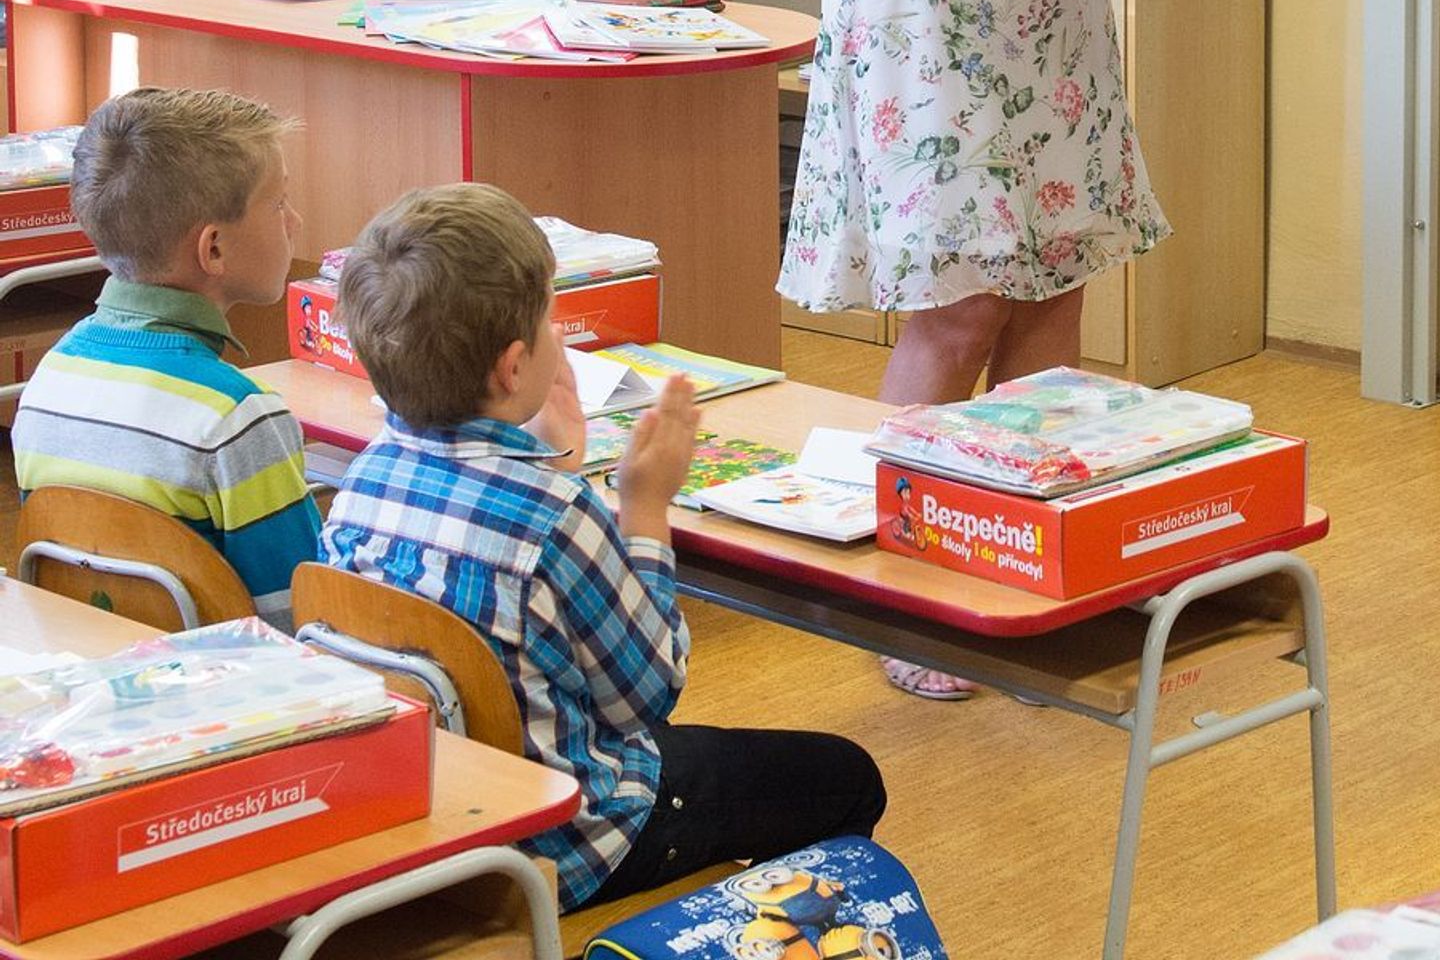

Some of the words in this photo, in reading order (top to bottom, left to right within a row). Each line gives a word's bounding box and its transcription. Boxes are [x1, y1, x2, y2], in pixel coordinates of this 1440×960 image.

[564, 317, 586, 334] kraj
[922, 494, 1044, 557] Bezpečně!
[1138, 500, 1209, 540] Středočeský
[1211, 496, 1233, 520] kraj
[924, 525, 940, 546] Do
[941, 534, 972, 563] školy
[980, 545, 996, 563] do
[997, 552, 1043, 581] přírody!
[146, 791, 269, 845] Středočeský
[271, 780, 307, 808] kraj
